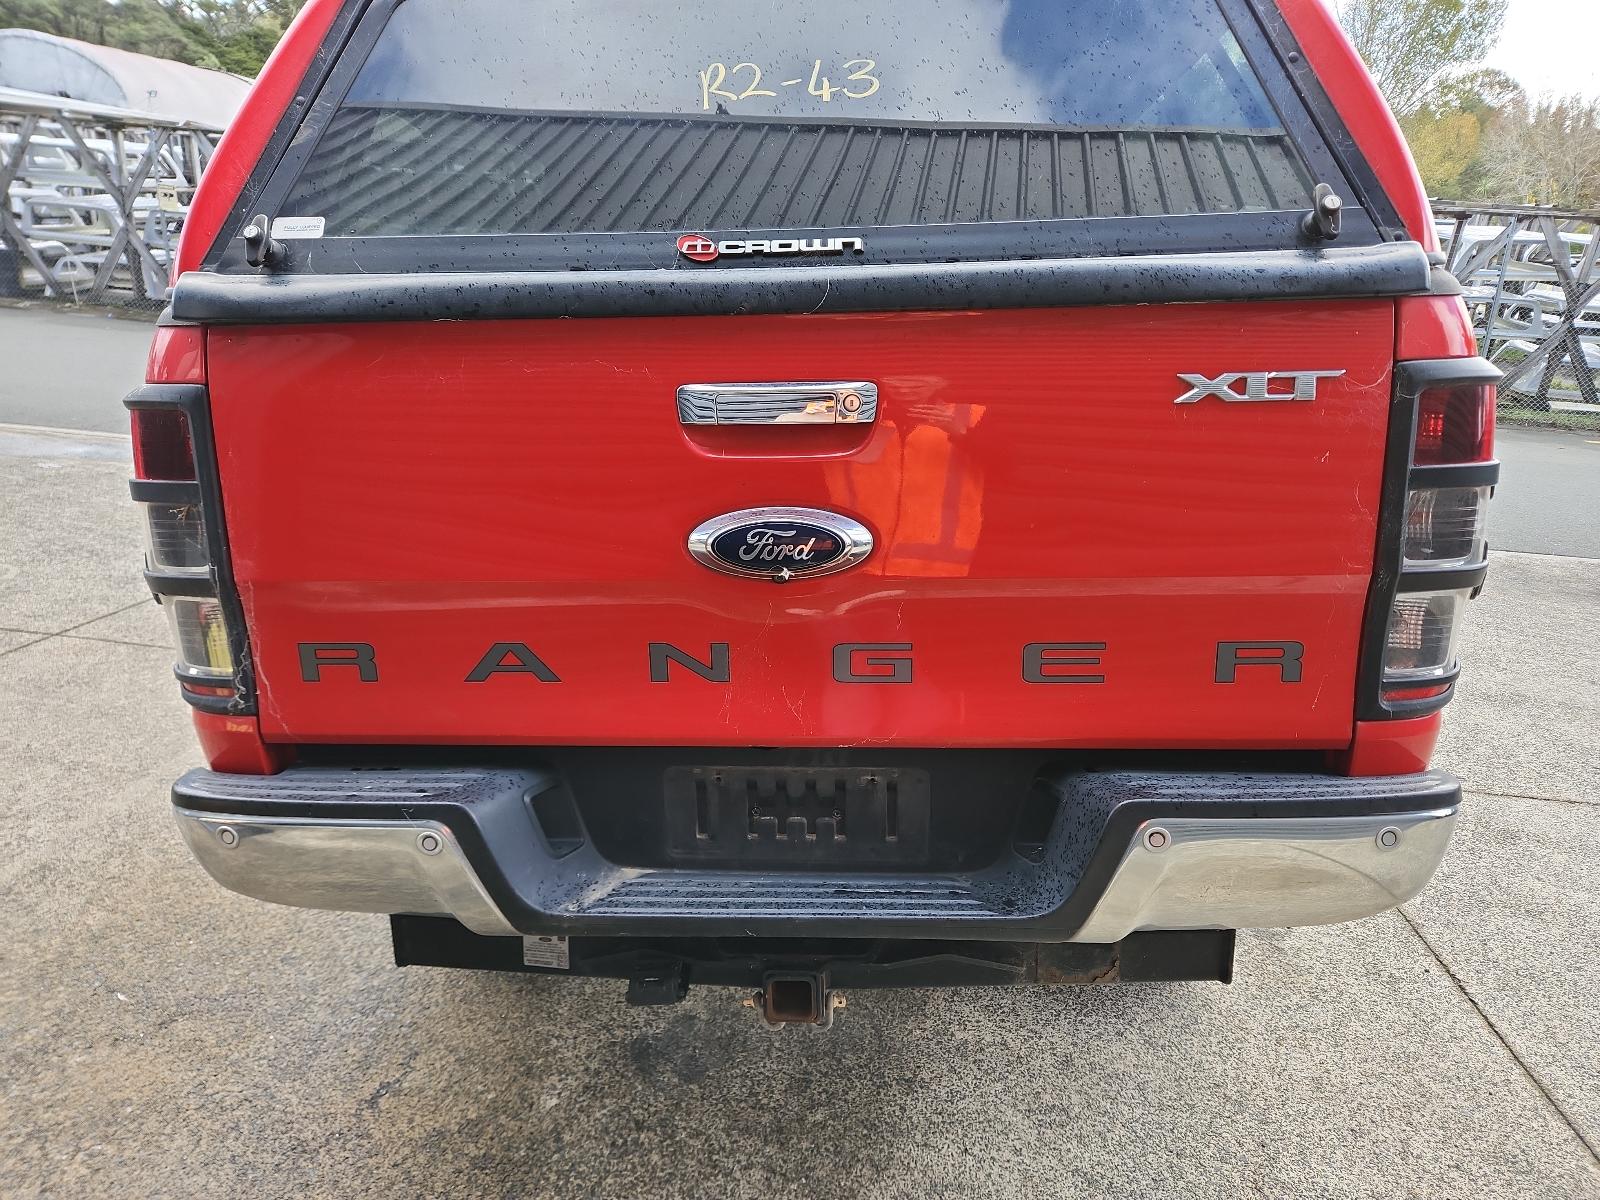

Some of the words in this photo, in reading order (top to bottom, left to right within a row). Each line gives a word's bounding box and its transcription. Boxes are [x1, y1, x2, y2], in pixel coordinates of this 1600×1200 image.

[699, 59, 880, 110] R2-43
[718, 237, 864, 253] CROWN
[1174, 369, 1346, 403] XLT
[738, 528, 815, 561] Ford
[297, 641, 1305, 684] RANGER
